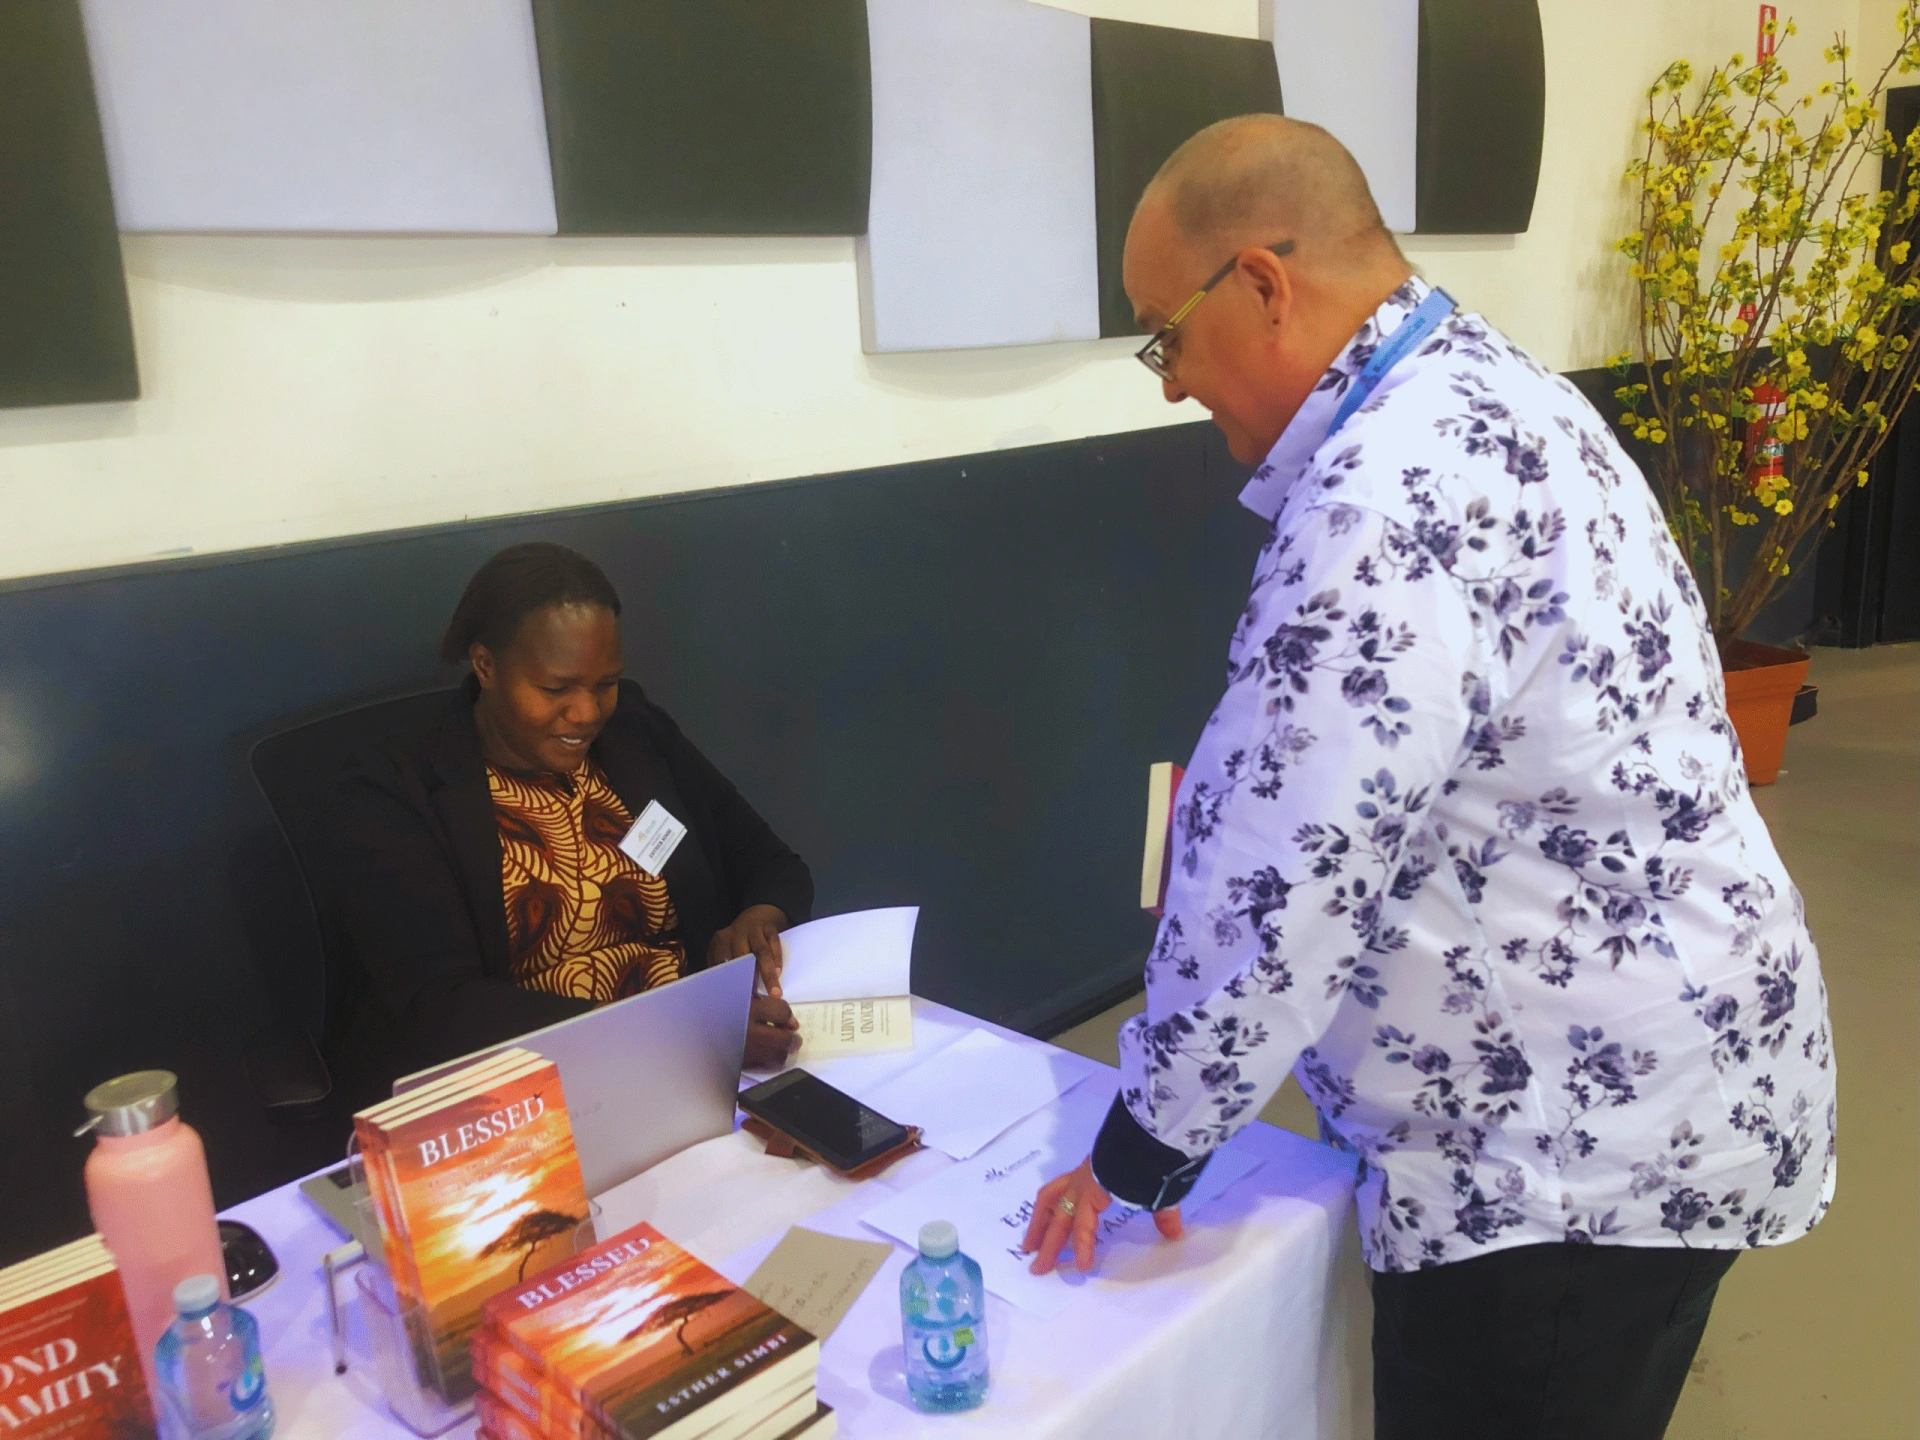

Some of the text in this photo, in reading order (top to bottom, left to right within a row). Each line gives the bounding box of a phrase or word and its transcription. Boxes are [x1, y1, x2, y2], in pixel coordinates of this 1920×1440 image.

[418, 1096, 545, 1168] BLESSED
[515, 1237, 651, 1310] BLESSED
[656, 1334, 787, 1414] ESTHER SIMBI
